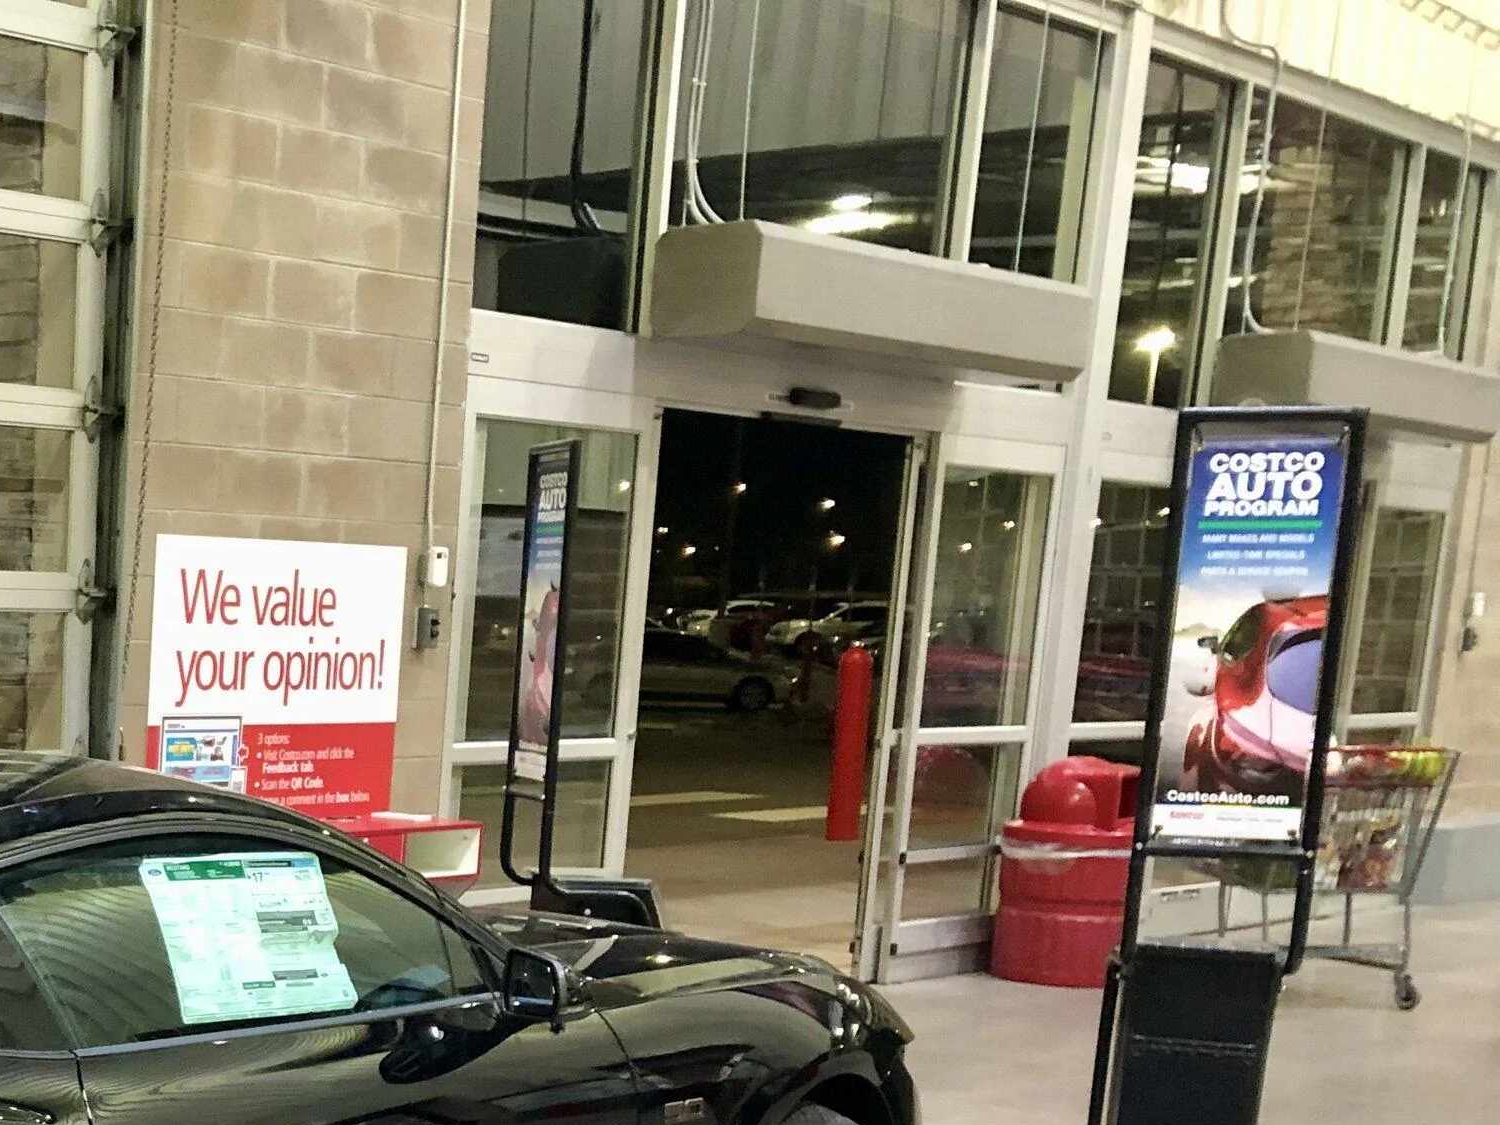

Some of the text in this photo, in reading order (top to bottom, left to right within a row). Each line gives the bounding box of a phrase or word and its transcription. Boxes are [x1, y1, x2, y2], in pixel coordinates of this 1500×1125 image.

[1209, 451, 1325, 473] COSTCO
[540, 471, 568, 489] COSTCO
[1206, 471, 1323, 500] AUTO
[538, 487, 567, 510] AUTO
[1203, 499, 1319, 516] PROGRAM
[180, 568, 337, 627] We value
[175, 636, 386, 708] your opinion!
[257, 732, 263, 744] 3
[316, 747, 329, 759] and
[262, 760, 298, 773] Feedback
[261, 779, 277, 790] Scan
[279, 779, 290, 790] the
[291, 777, 303, 790] QR
[336, 791, 349, 803] box
[1166, 789, 1290, 805] CostcoAuto.com
